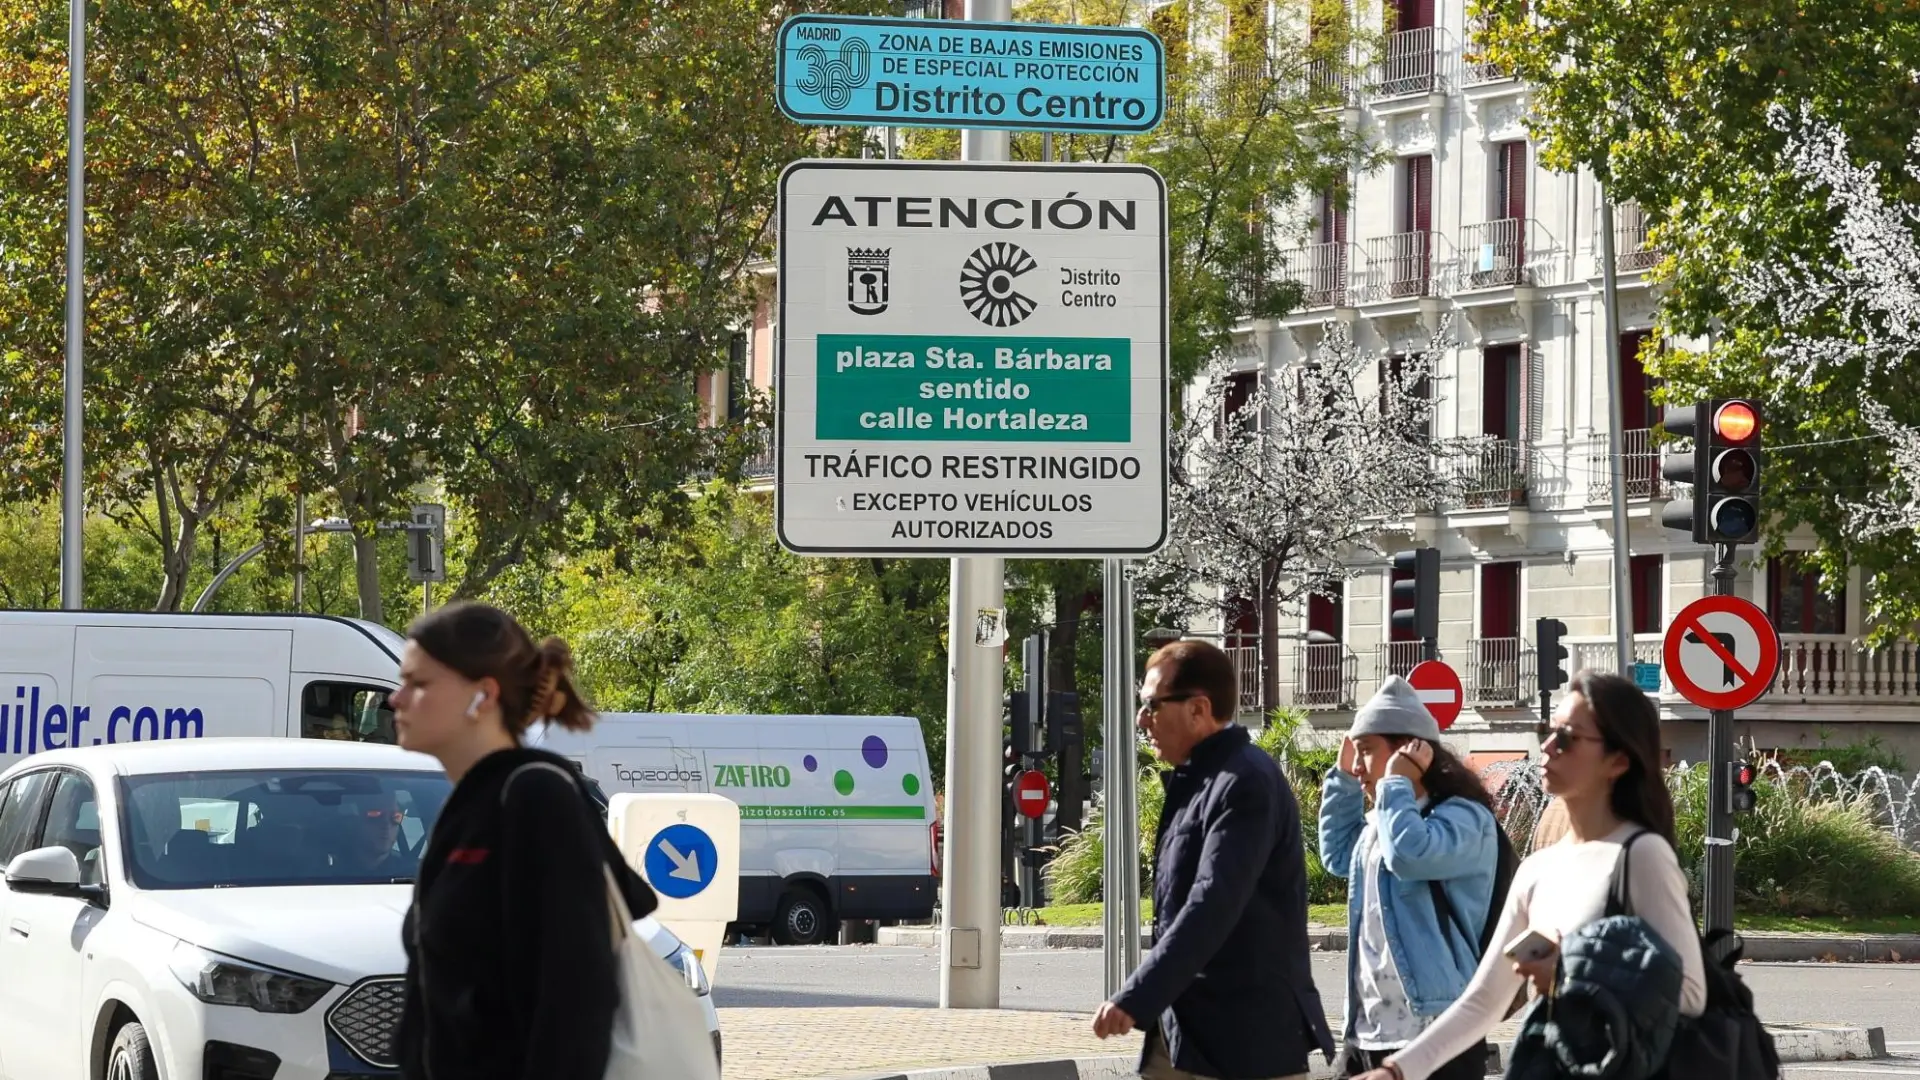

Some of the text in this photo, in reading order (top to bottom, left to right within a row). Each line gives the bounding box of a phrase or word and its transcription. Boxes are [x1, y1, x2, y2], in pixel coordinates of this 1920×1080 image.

[796, 26, 841, 41] MADRID
[879, 34, 1143, 62] ZONA DE BAJAS EMISIONES
[883, 57, 1139, 84] DE ESPECIAL PROTECCIÓN
[876, 82, 1145, 121] Distrito Centro
[812, 192, 1135, 230] ATENCIÓN
[1061, 290, 1117, 307] Centro
[836, 346, 1112, 372] plaza Sta. Bárbara
[919, 378, 1030, 400] sentido
[860, 407, 1088, 431] calle Hortaleza
[804, 449, 1141, 480] TRÁFICO RESTRINGIDO
[853, 490, 1092, 512] EXCEPTO VEHÍCULOS
[891, 520, 1053, 539] AUTORIZADOS
[611, 764, 791, 788] Tapizados ZAFIRO
